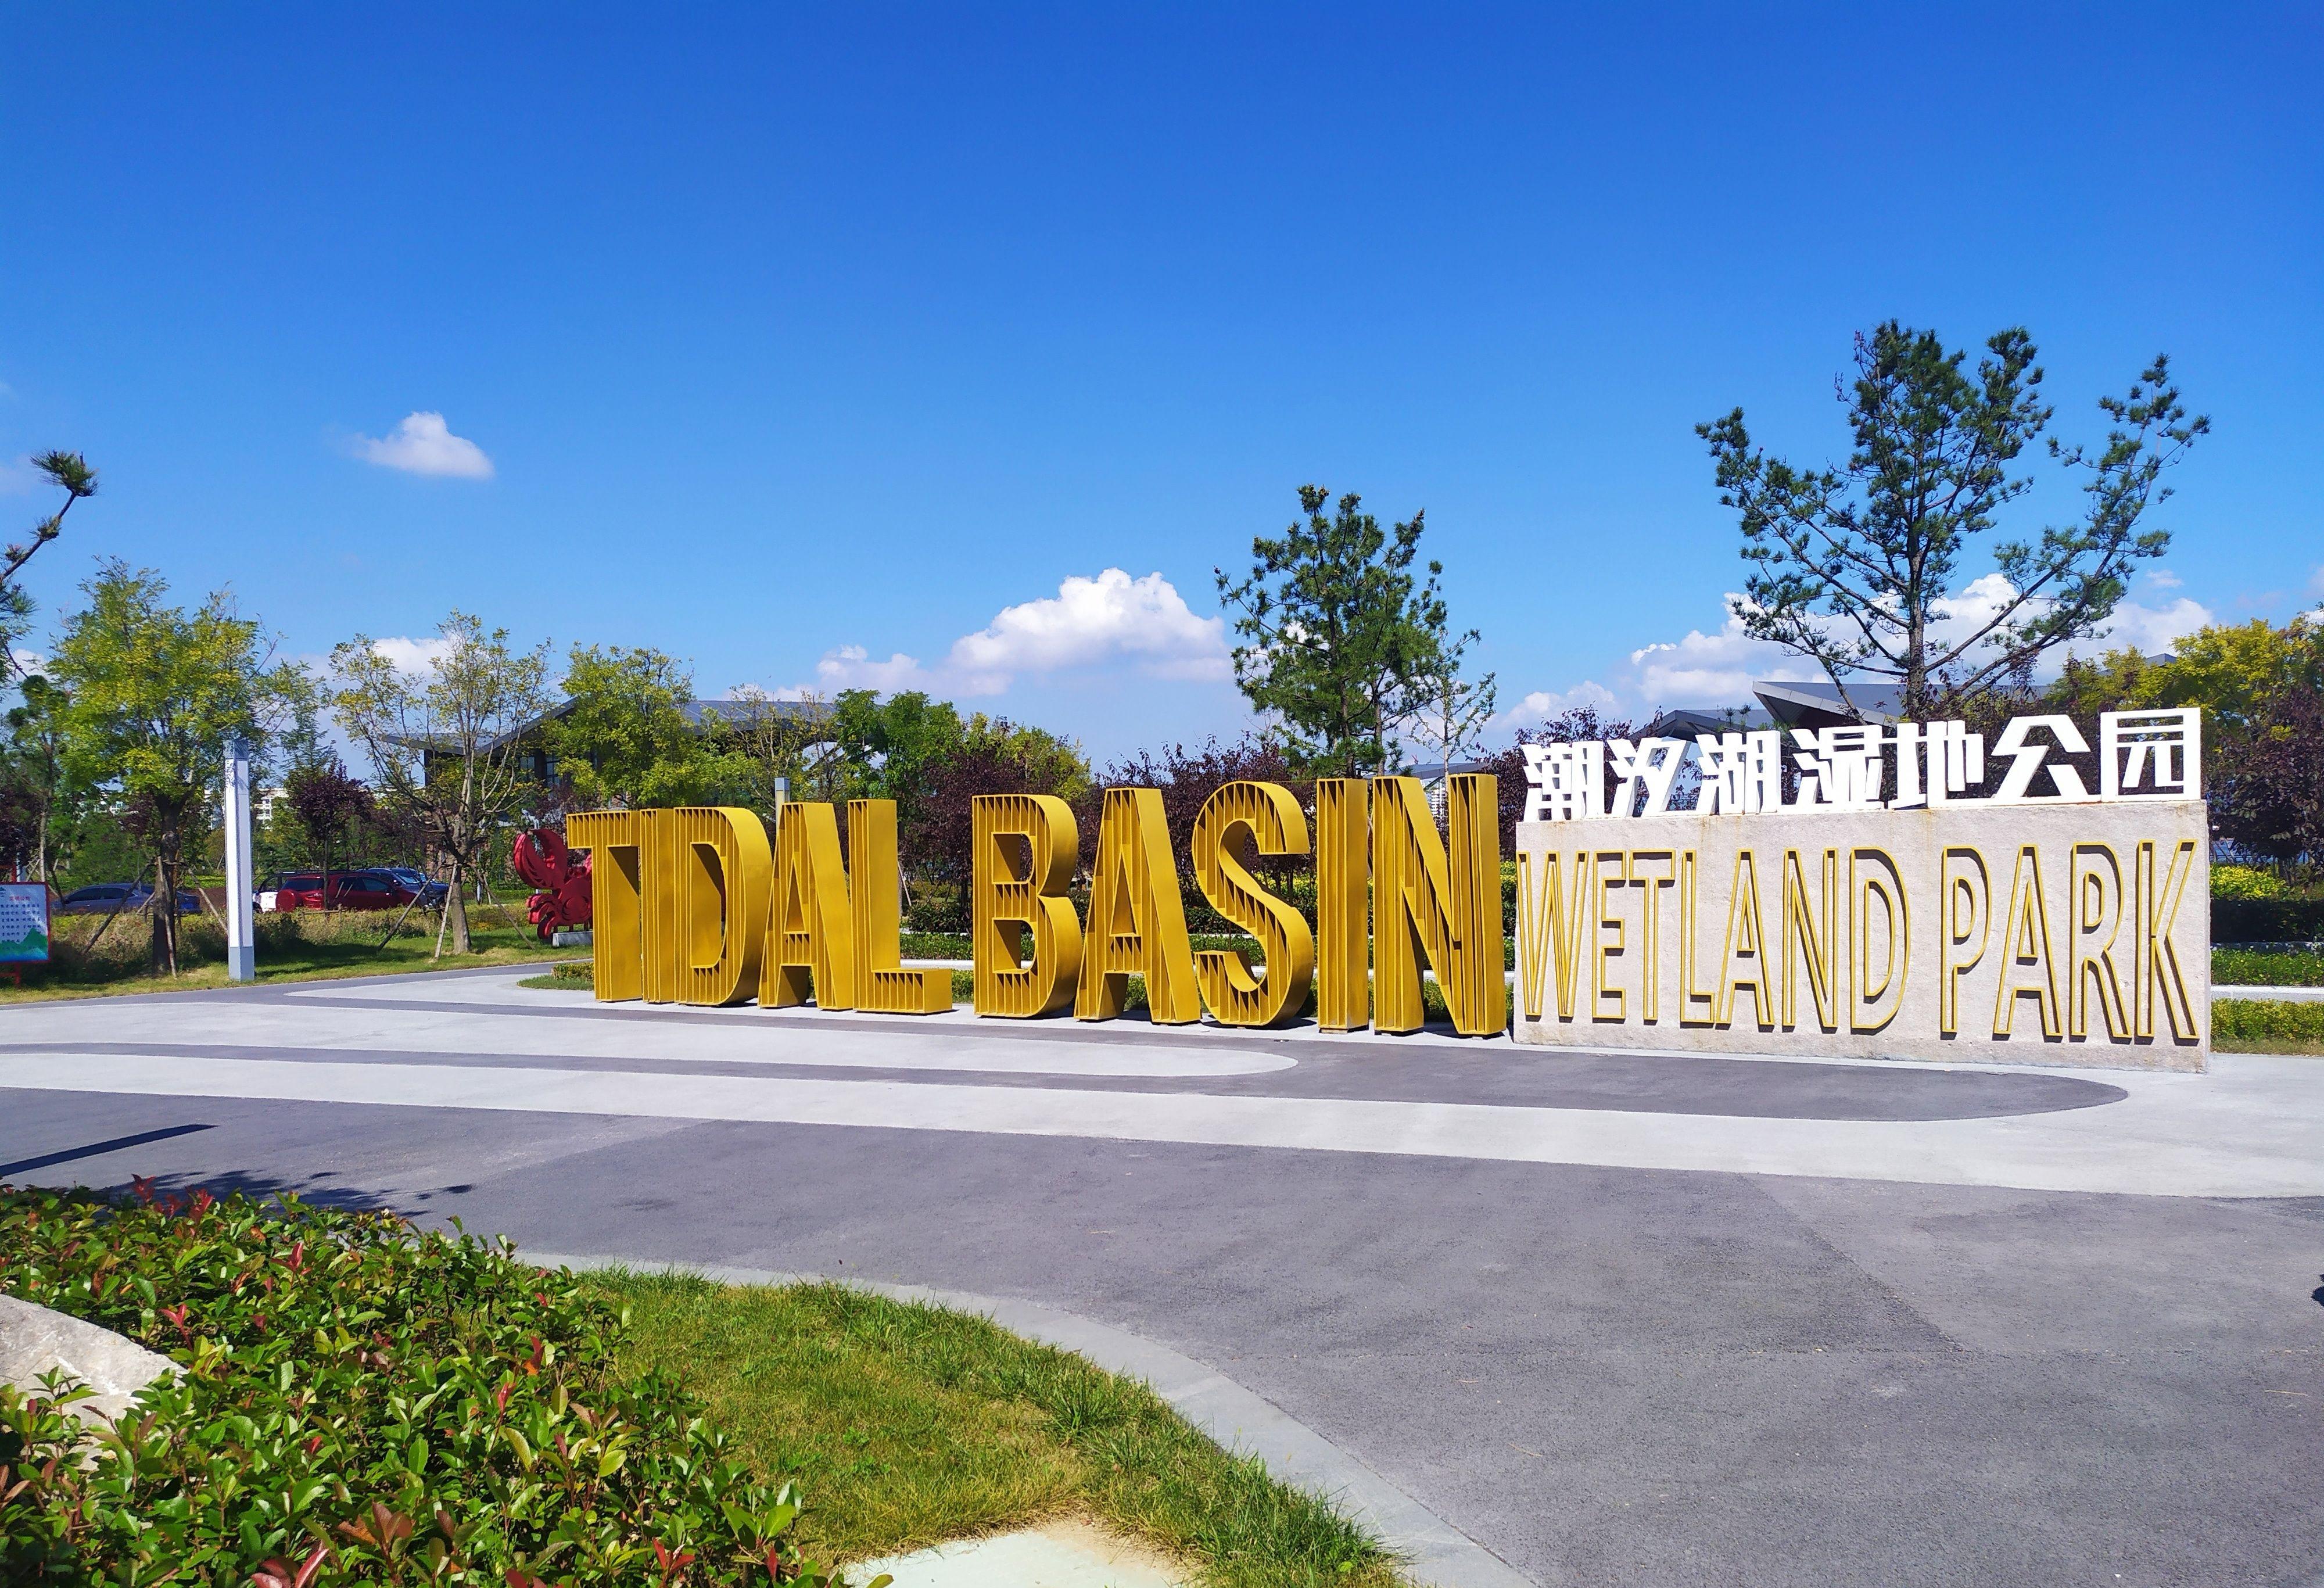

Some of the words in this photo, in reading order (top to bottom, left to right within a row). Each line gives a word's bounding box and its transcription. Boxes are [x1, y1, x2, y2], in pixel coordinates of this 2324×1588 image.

[1521, 707, 2201, 822] 潮汐湖湿地公园
[566, 798, 952, 1013] TIDAL
[972, 773, 1506, 1035] BASIN
[1517, 846, 1909, 1030] WETLAND
[1942, 839, 2199, 1039] PARK
